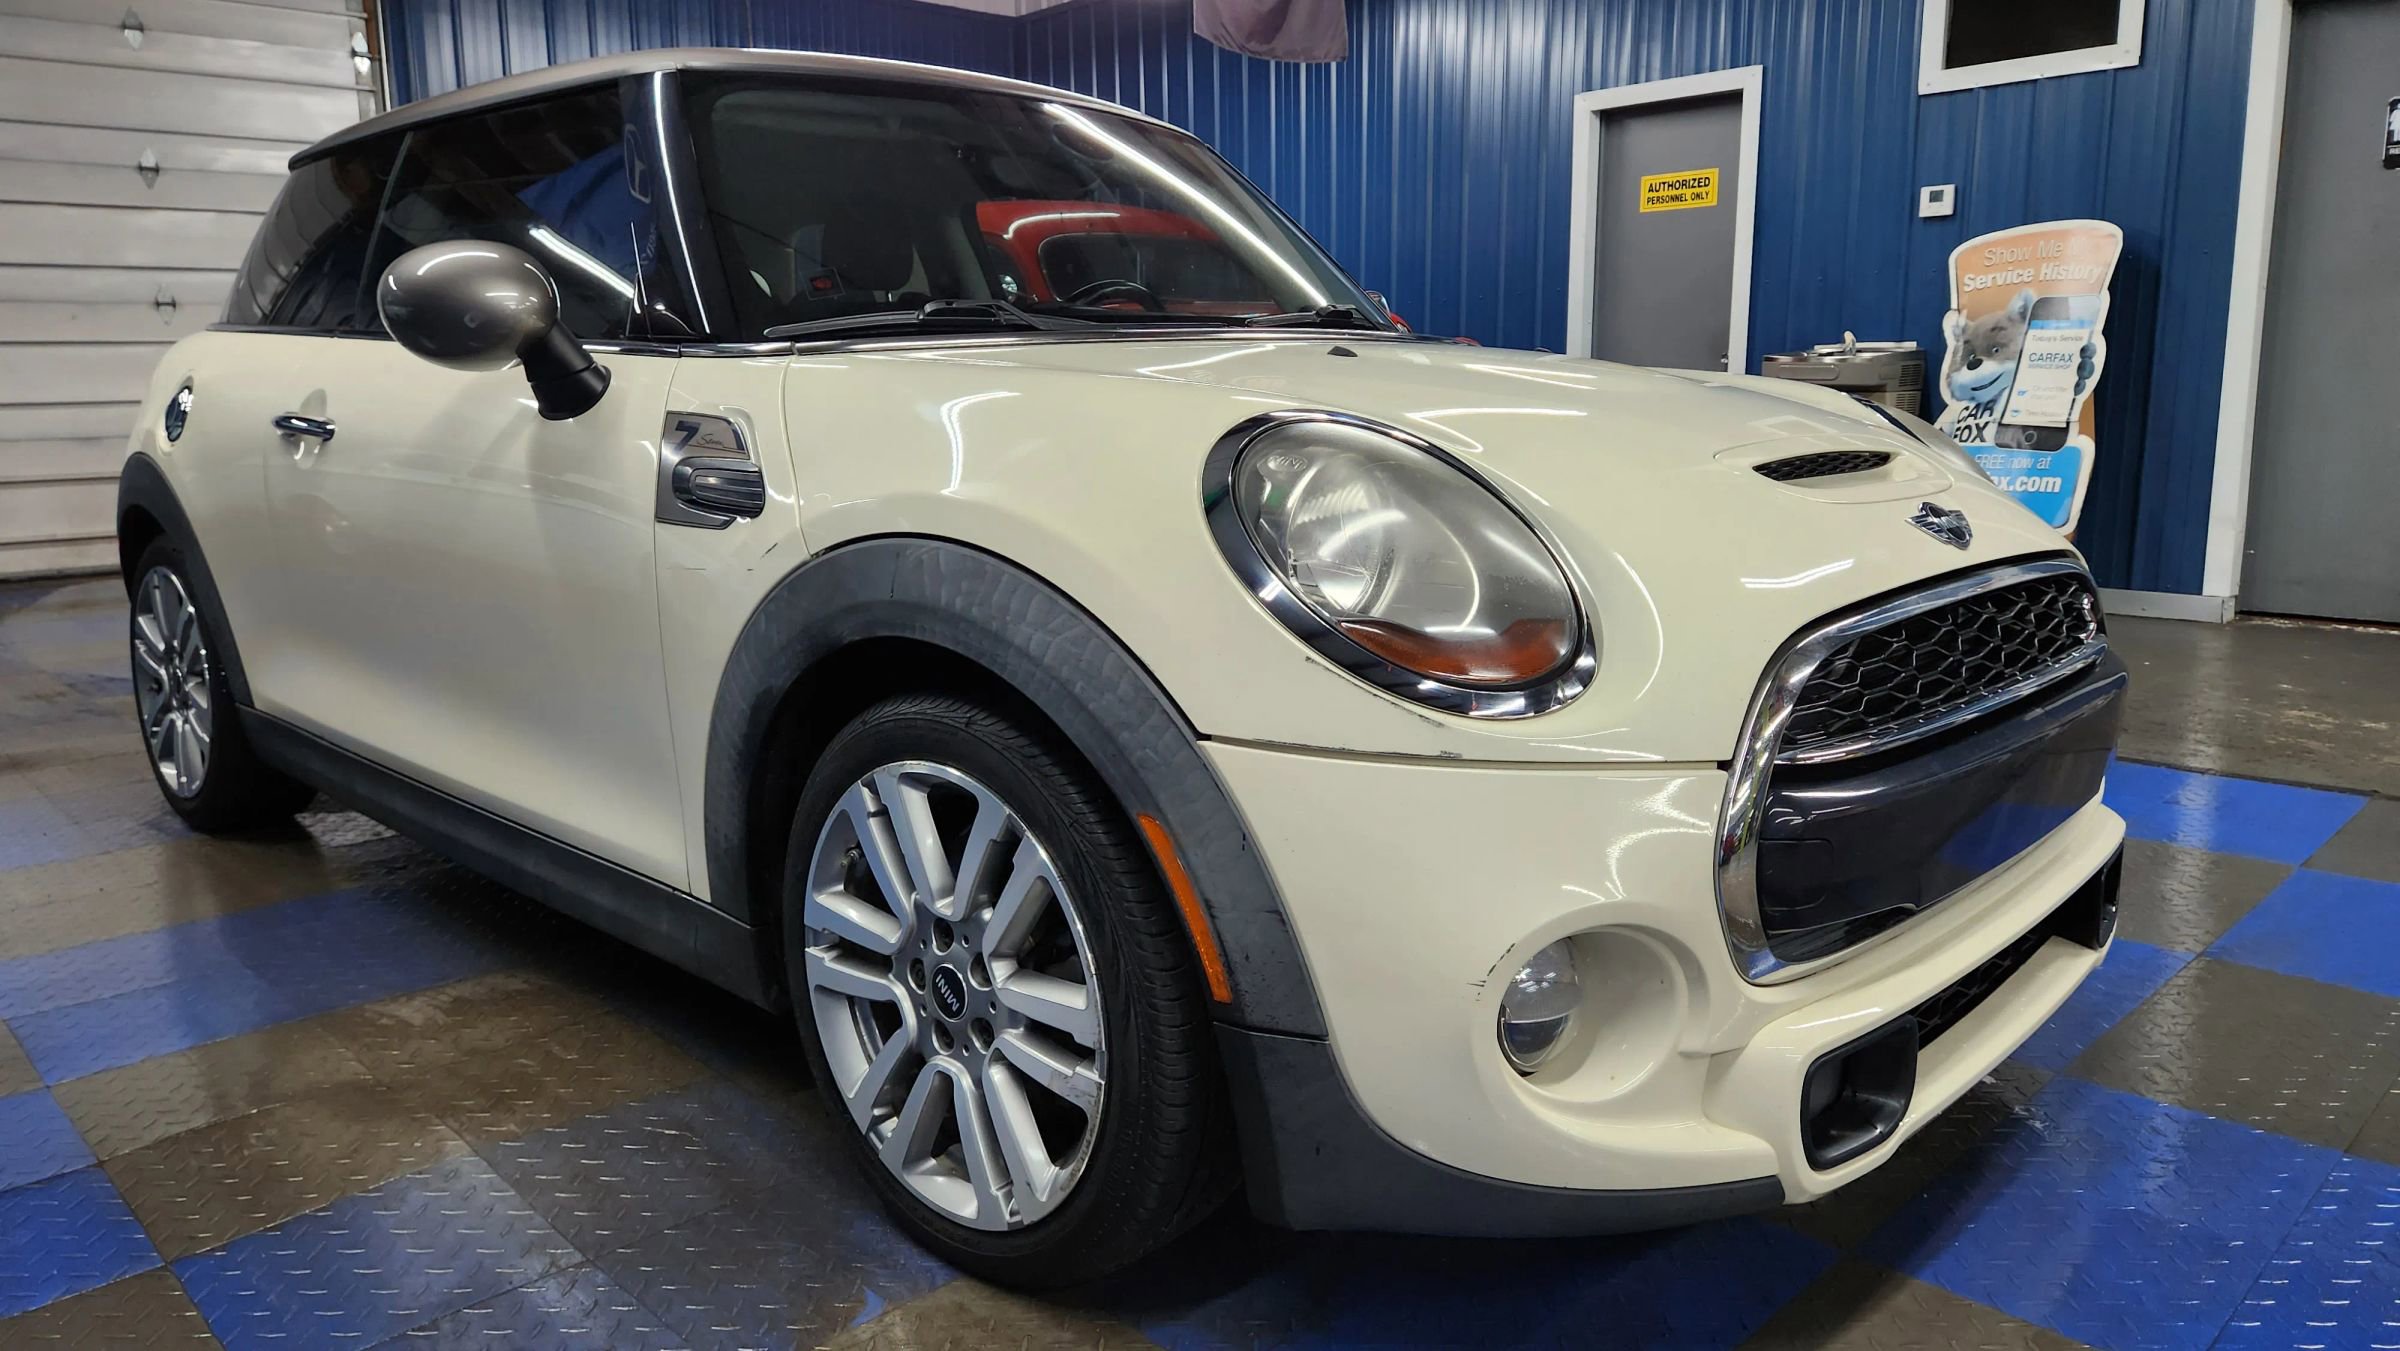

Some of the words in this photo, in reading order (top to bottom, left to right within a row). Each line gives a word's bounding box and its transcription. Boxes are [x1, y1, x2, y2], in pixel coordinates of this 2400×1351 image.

[1648, 177, 1711, 193] AUTHORIZED
[1646, 193, 1688, 205] PERSONNEL
[1690, 191, 1710, 201] ONLY
[1983, 245, 2033, 267] Show
[2036, 240, 2064, 260] Me
[1962, 266, 2035, 293] Service
[2038, 261, 2103, 285] History
[2028, 352, 2075, 363] CARFAX
[1956, 399, 1997, 425] CAR
[674, 420, 702, 452] 7
[1952, 420, 1991, 444] FOX
[1975, 454, 2007, 469] FREE
[2007, 457, 2035, 470] now
[2036, 455, 2052, 470] at
[935, 973, 960, 1012] MINI
